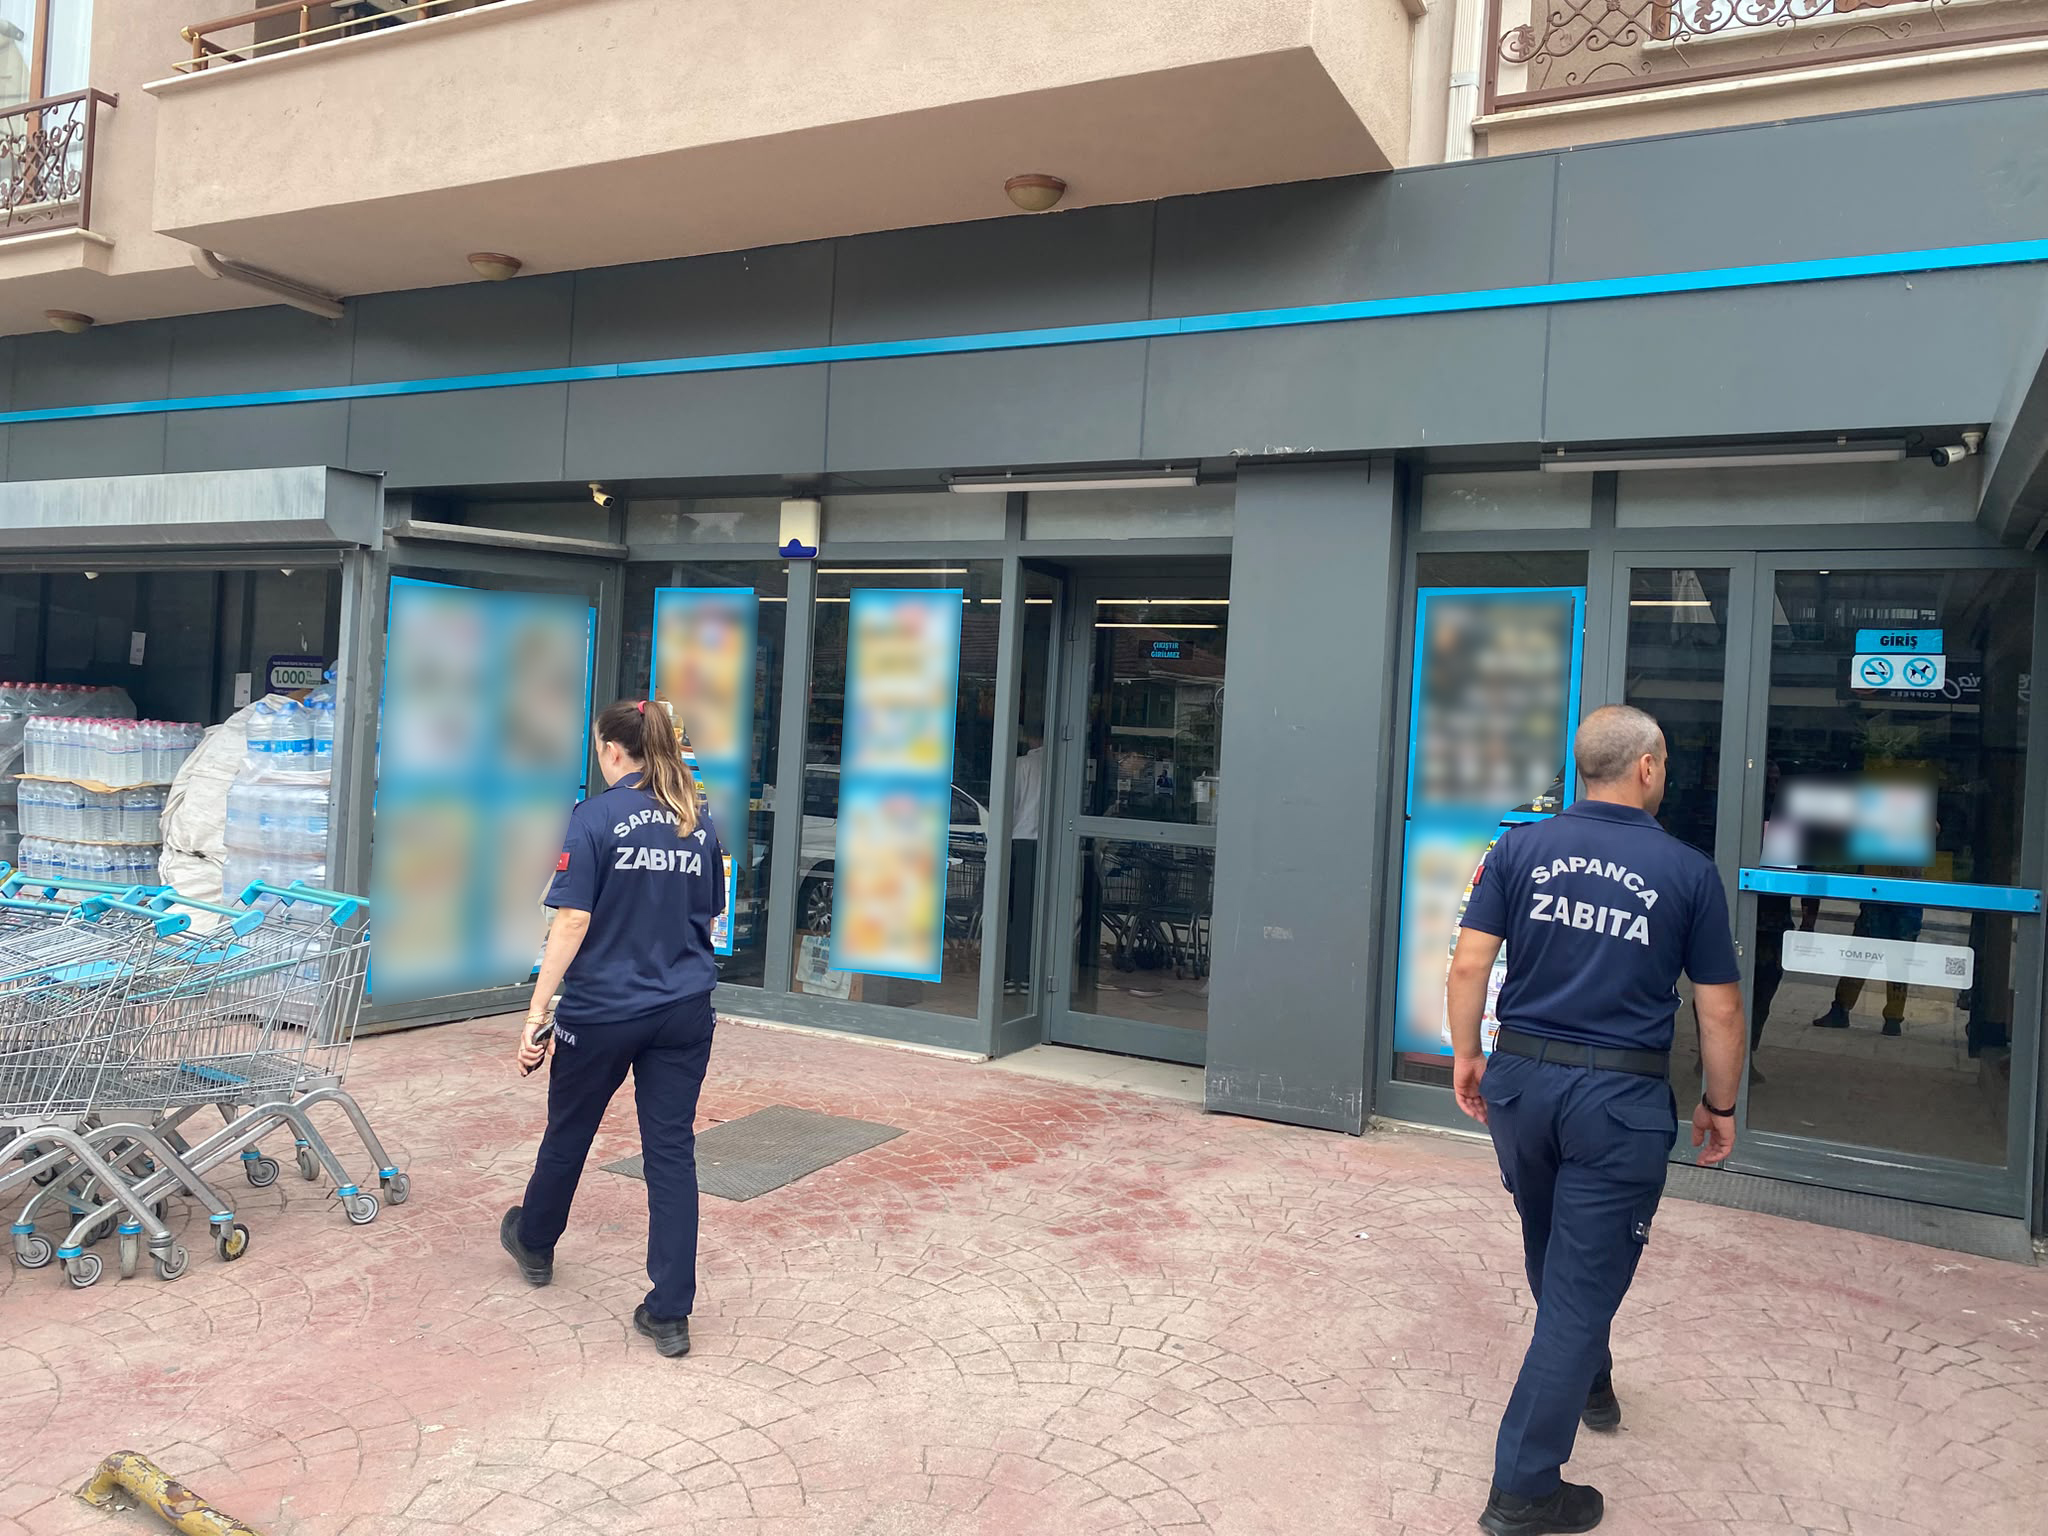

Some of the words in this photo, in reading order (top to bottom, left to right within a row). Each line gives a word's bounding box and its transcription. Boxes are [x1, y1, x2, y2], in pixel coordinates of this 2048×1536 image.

[1880, 633, 1917, 649] GİRİŞ
[275, 670, 305, 684] 1.000
[613, 809, 707, 846] SAPANA
[614, 847, 702, 876] ZABITA
[1531, 856, 1659, 910] SAPANCA
[1529, 893, 1650, 945] ZABITA
[1839, 950, 1863, 960] TOM
[1865, 952, 1884, 961] PAY
